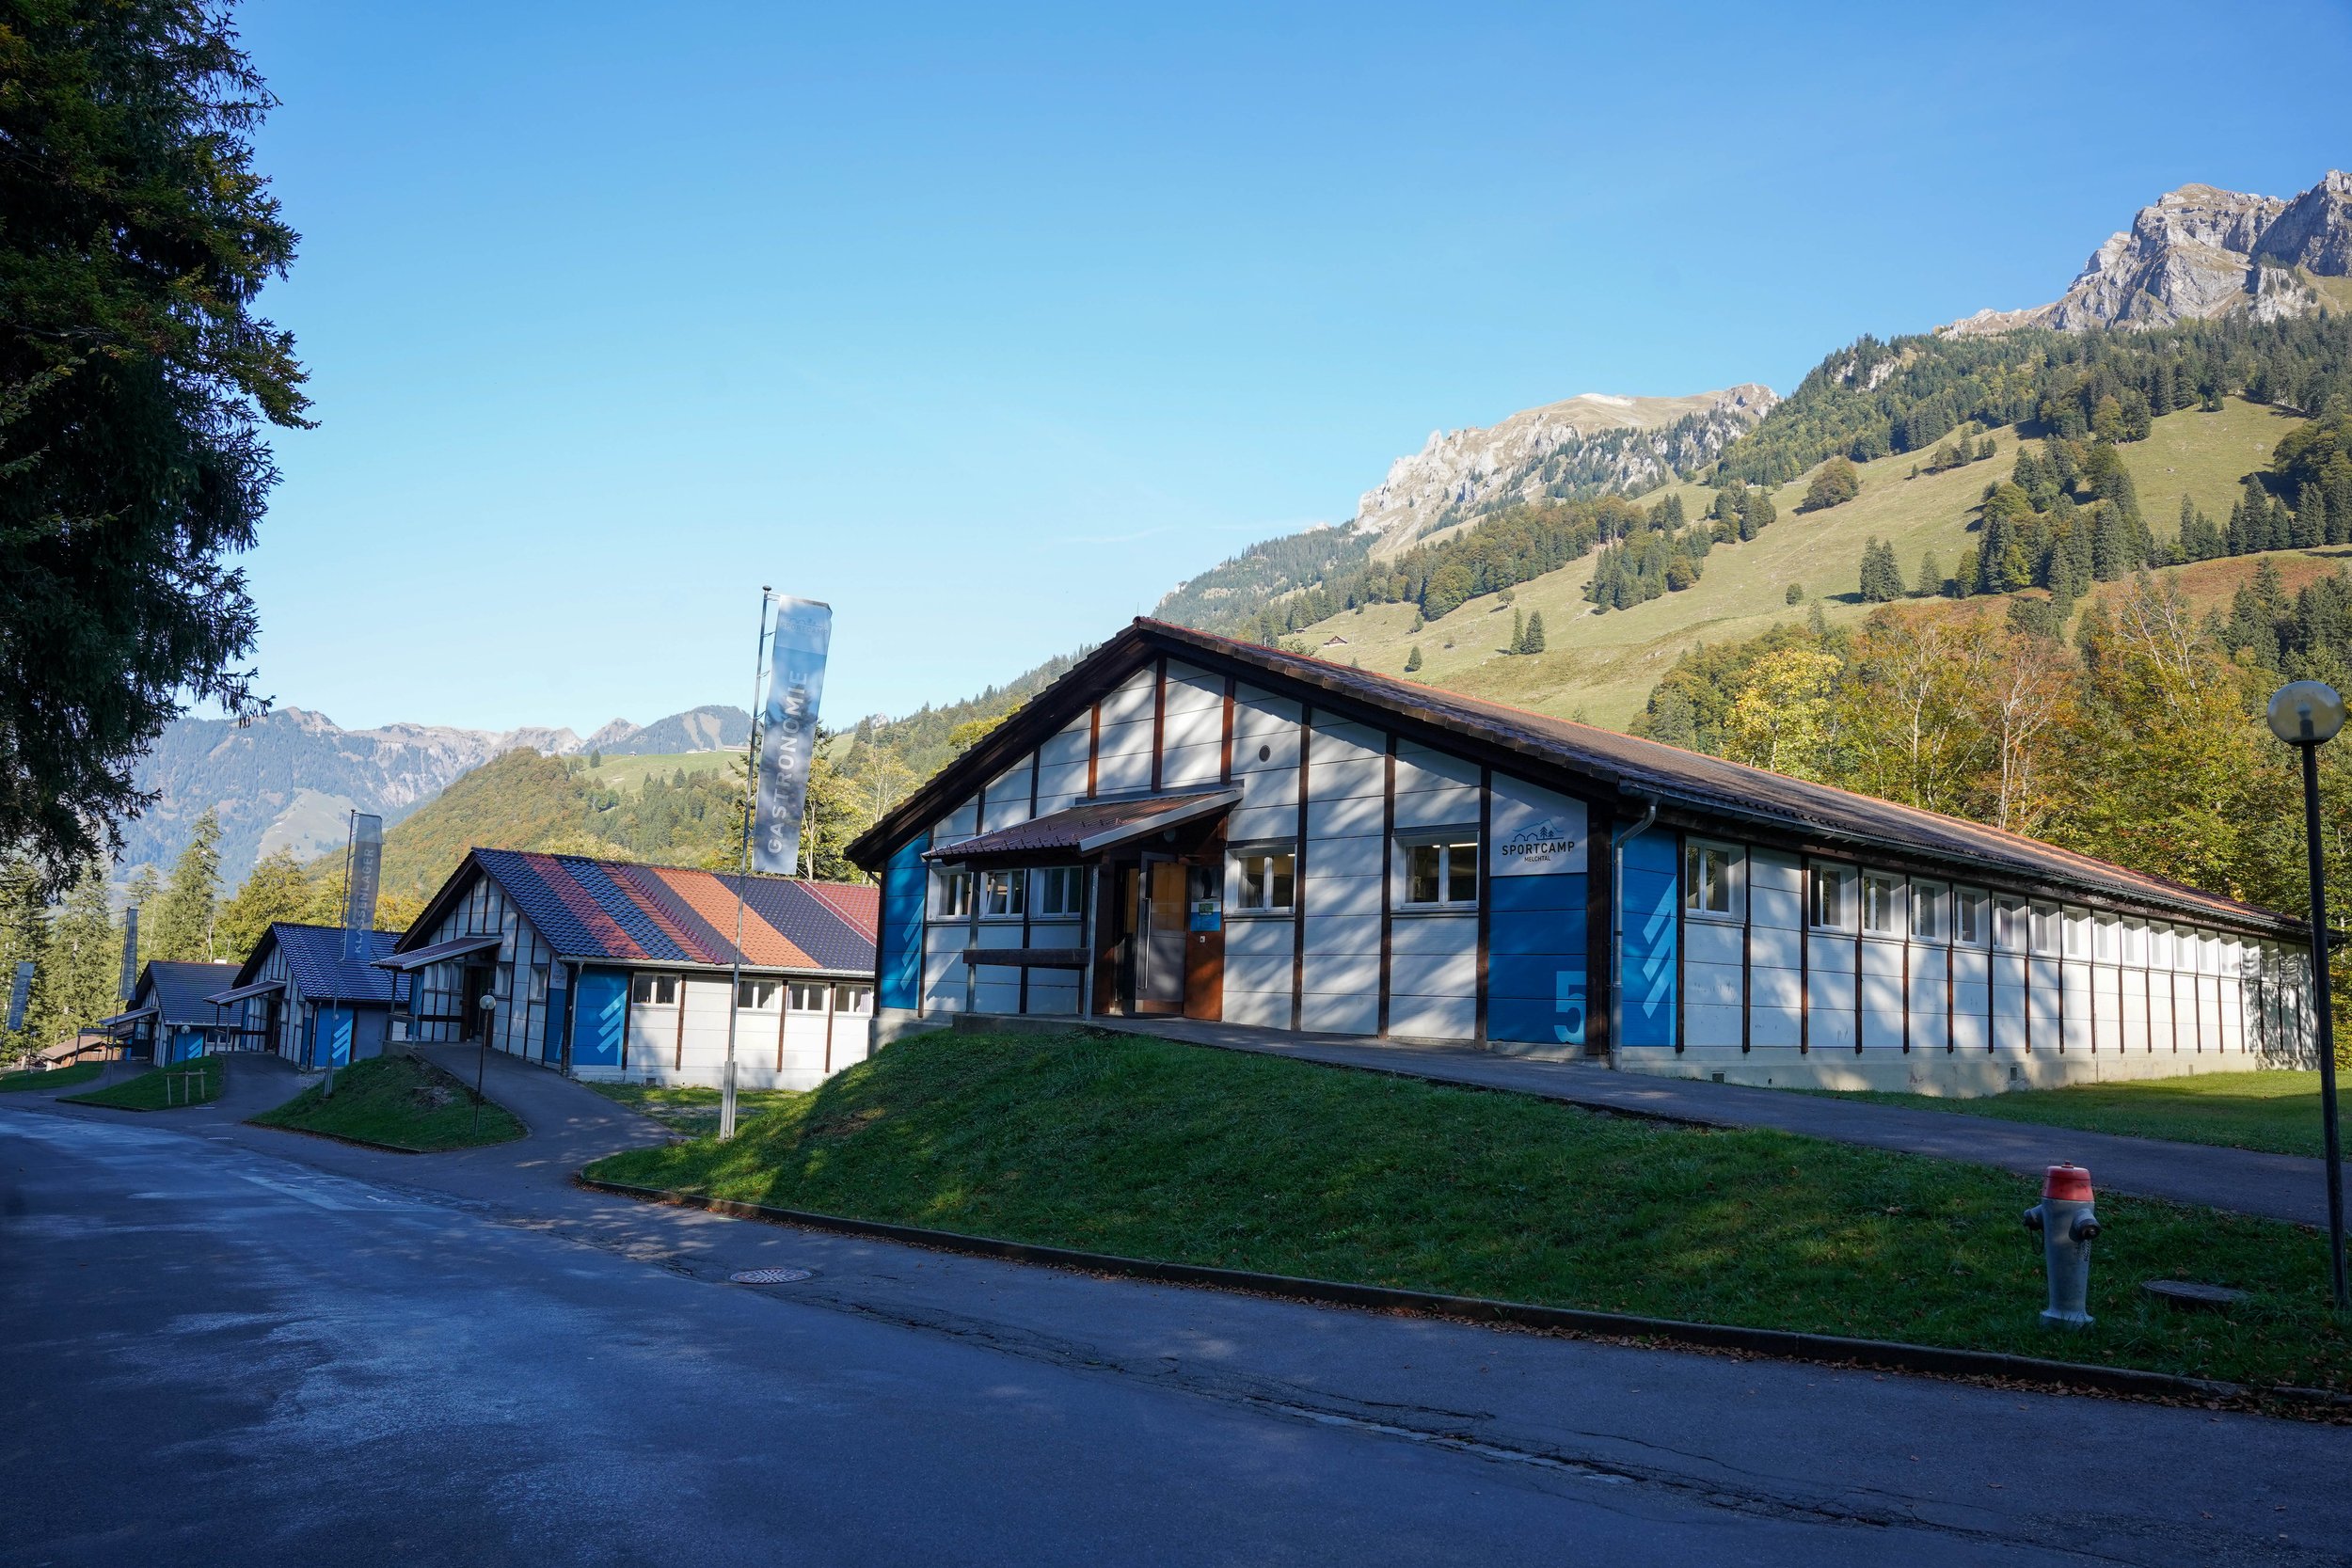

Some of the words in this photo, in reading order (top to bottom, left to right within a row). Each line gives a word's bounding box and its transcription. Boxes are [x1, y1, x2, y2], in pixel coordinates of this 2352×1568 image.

[768, 670, 807, 854] GASTRONOMIE
[1502, 841, 1575, 856] SPORTCAMP
[354, 848, 374, 954] KLASSENLAGER
[1554, 971, 1587, 1044] 5
